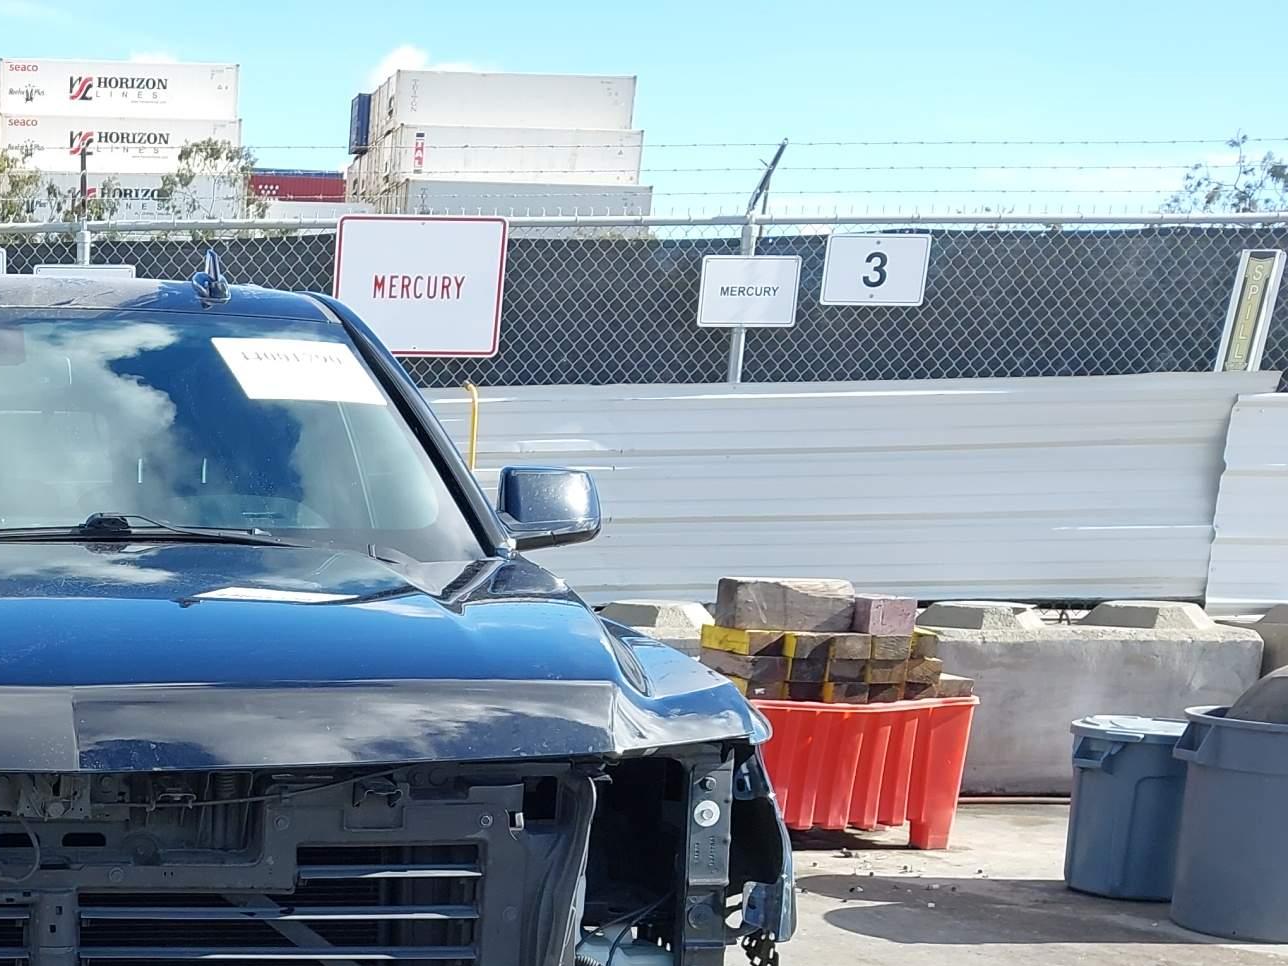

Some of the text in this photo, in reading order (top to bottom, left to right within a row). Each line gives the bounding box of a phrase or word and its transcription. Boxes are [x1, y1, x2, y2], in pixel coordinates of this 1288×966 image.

[8, 64, 39, 72] seaco
[96, 76, 168, 90] HORIZON
[95, 91, 159, 99] LINES
[7, 117, 38, 127] seaco
[97, 131, 170, 145] HORIZON
[862, 251, 888, 288] 3
[372, 274, 466, 300] MERCURY
[719, 286, 780, 297] MERCURY
[1233, 264, 1265, 359] SPILL
